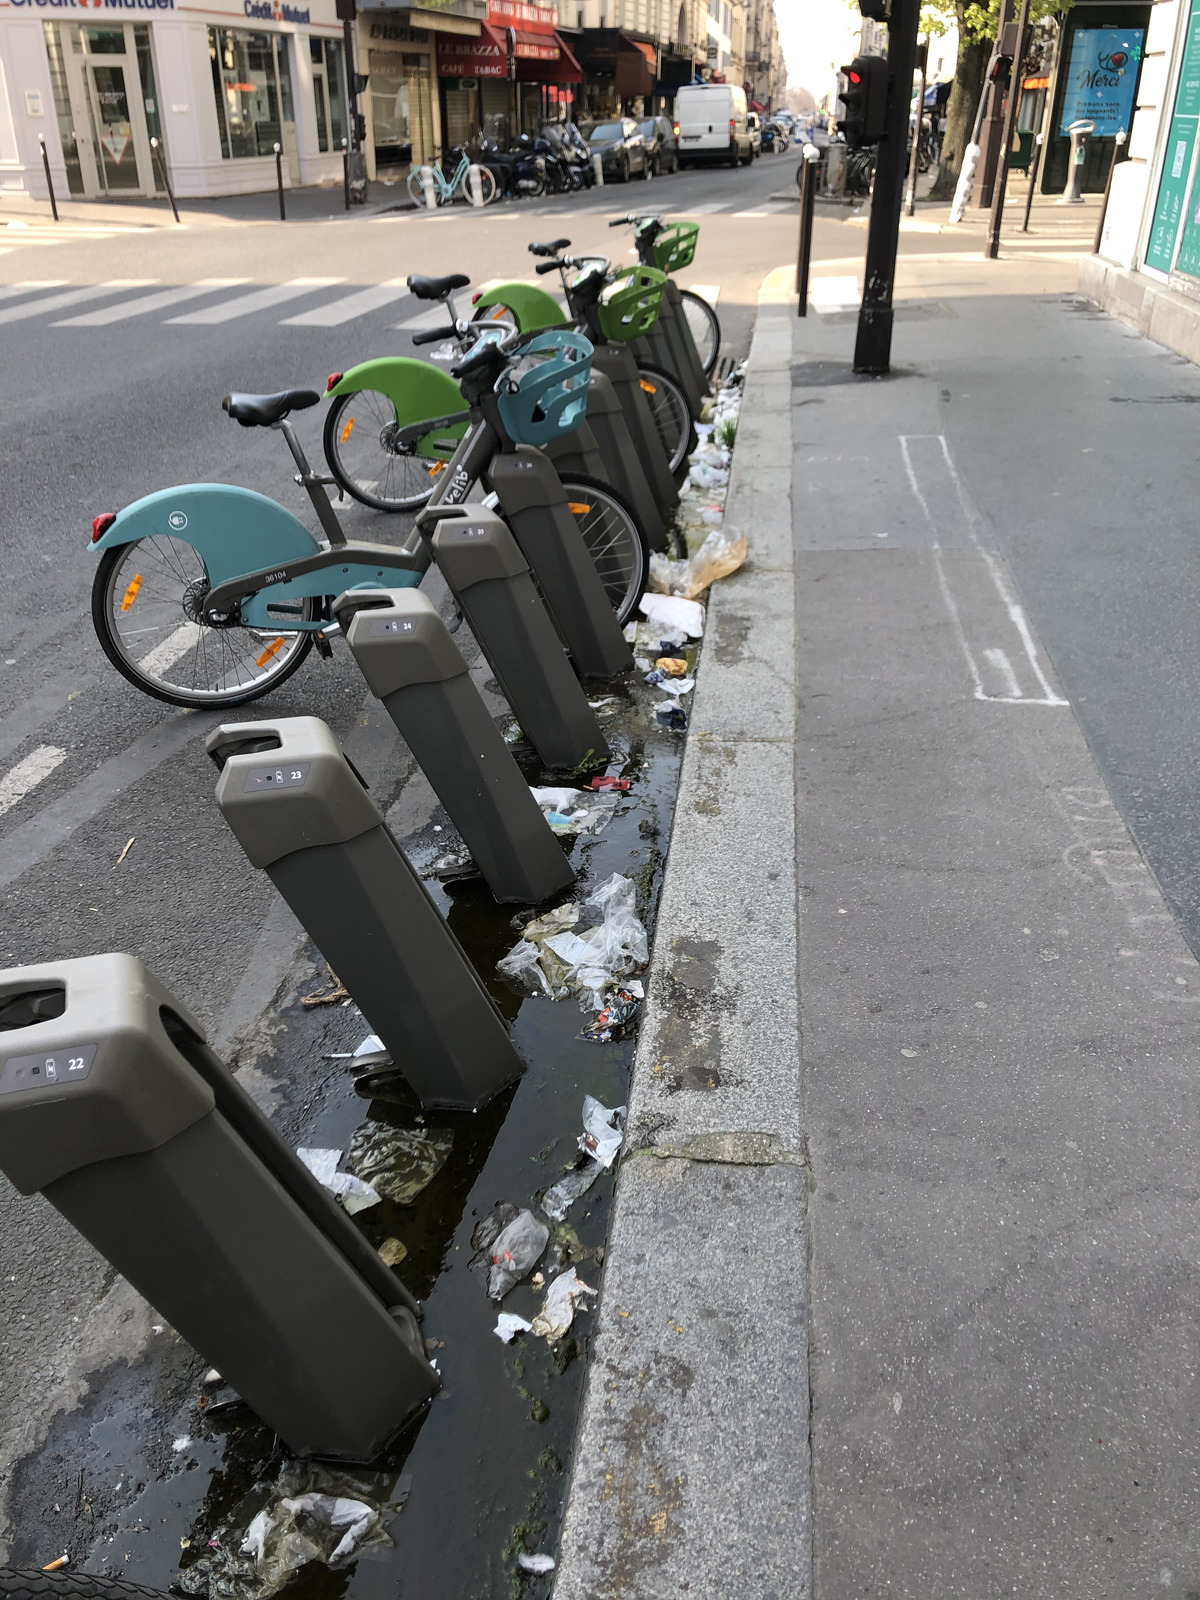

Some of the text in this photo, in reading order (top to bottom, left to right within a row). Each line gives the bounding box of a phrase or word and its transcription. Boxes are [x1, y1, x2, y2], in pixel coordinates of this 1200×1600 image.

[438, 43, 500, 57] LE BRAZZA
[472, 65, 503, 76] TABAC
[1076, 69, 1121, 90] Merci
[264, 570, 287, 584] 36104
[403, 622, 412, 630] 24
[290, 770, 302, 780] 23
[68, 1057, 84, 1071] 22
